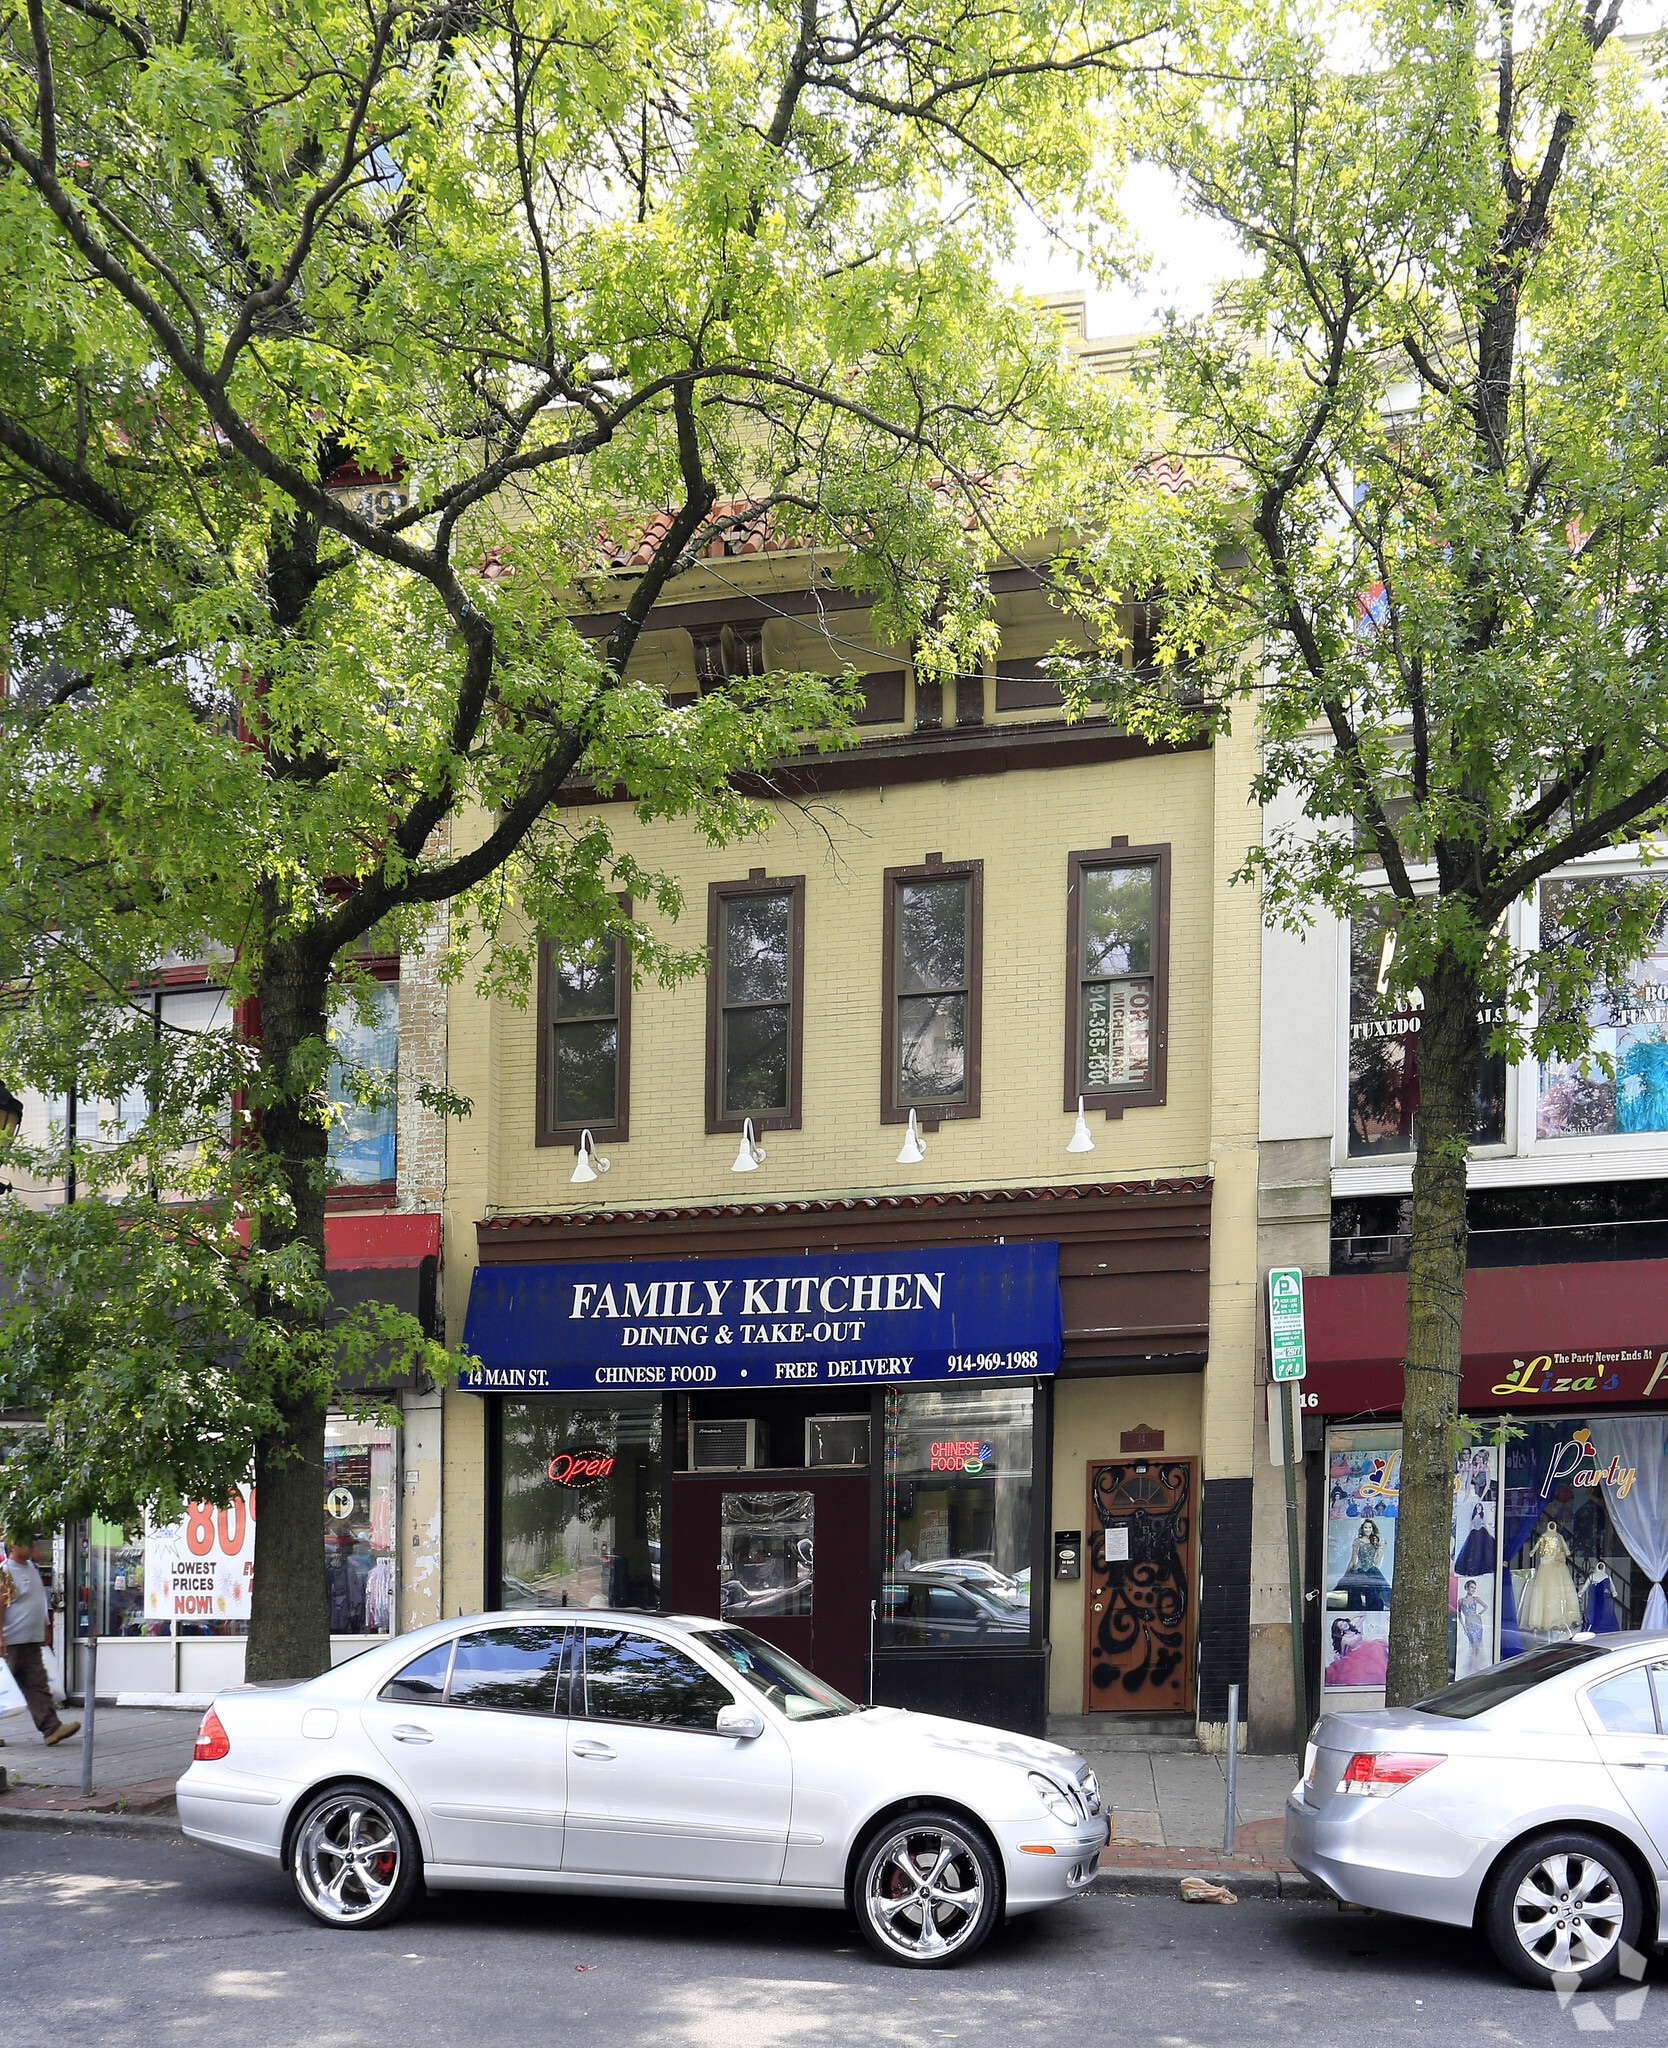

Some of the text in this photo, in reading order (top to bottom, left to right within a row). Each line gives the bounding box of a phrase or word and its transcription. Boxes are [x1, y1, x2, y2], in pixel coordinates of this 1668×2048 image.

[1618, 1006, 1668, 1025] TUXE
[1129, 981, 1149, 1081] FOR RENT
[1351, 1017, 1421, 1039] TUXEDO
[569, 1272, 946, 1319] FAMILY KITCHEN
[1279, 1280, 1289, 1295] P
[1273, 1298, 1280, 1314] 2
[621, 1321, 866, 1346] DINING & TAKE-OUT
[948, 1351, 1038, 1373] 914-969-1988
[1554, 1350, 1652, 1365] The Party Never Ends At
[595, 1366, 717, 1384] CHINESE FOOD
[775, 1357, 914, 1379] FREE DELIVERY
[1491, 1355, 1620, 1395] Liza's
[468, 1369, 550, 1386] 14 MAIN ST.
[1300, 1393, 1318, 1408] 16
[930, 1441, 980, 1457] CHINESE
[548, 1454, 615, 1483] Open
[930, 1456, 964, 1472] FOOD
[1540, 1440, 1636, 1500] Party
[187, 1487, 256, 1556] 80
[171, 1562, 216, 1574] LOWEST
[172, 1578, 214, 1591] PRICES
[174, 1596, 213, 1614] NOW!
